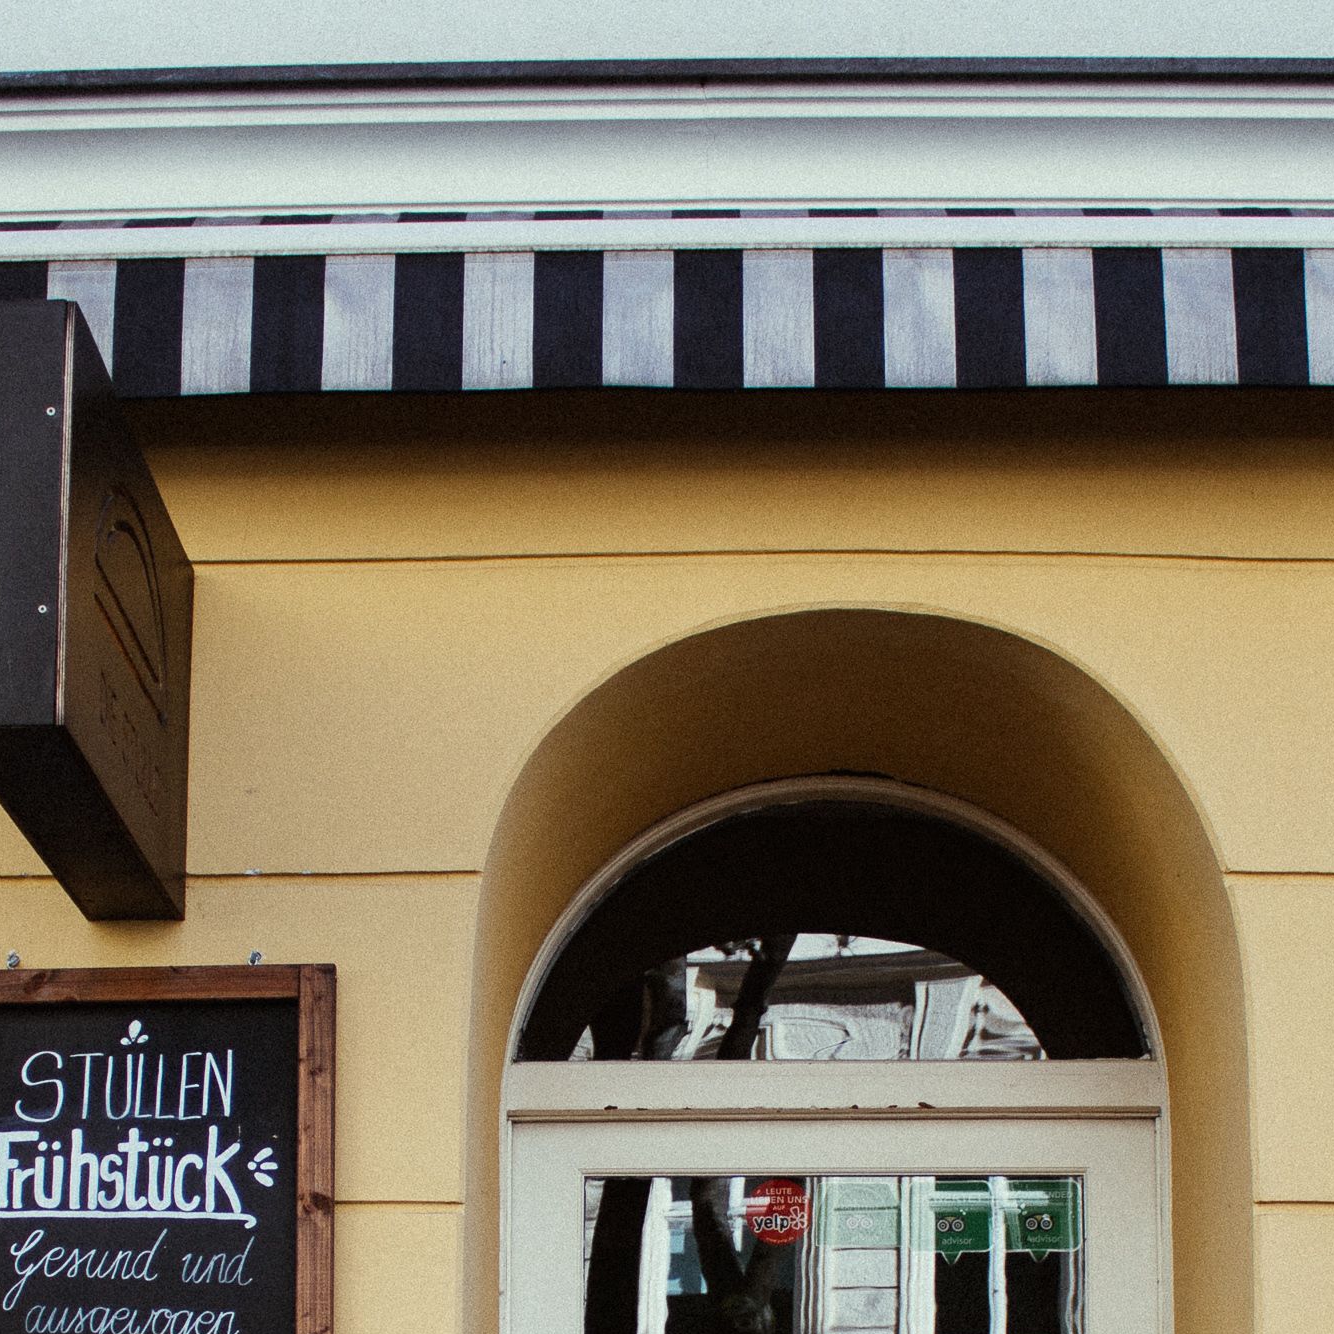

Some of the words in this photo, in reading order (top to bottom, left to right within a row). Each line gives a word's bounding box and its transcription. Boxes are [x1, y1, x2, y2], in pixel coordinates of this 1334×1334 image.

[14, 1049, 233, 1123] STULLEN
[753, 1213, 790, 1233] yelp
[2, 1229, 168, 1311] Gesund
[181, 1236, 254, 1286] und
